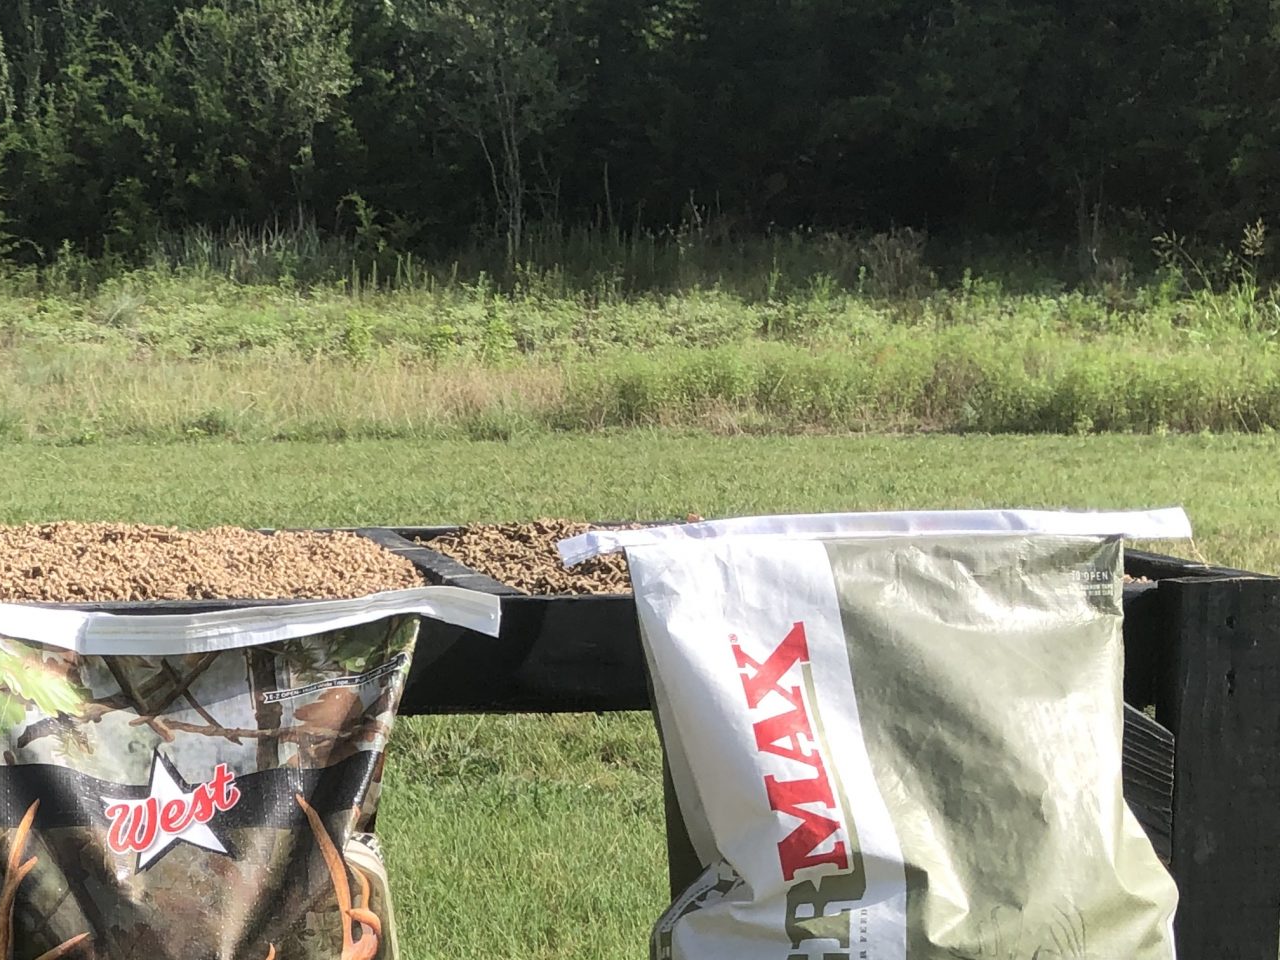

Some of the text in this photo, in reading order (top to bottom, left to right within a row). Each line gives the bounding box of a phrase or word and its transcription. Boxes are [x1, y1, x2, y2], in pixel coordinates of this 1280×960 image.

[1083, 570, 1109, 581] OPEN
[105, 763, 241, 854] West
[860, 908, 869, 943] FEED
